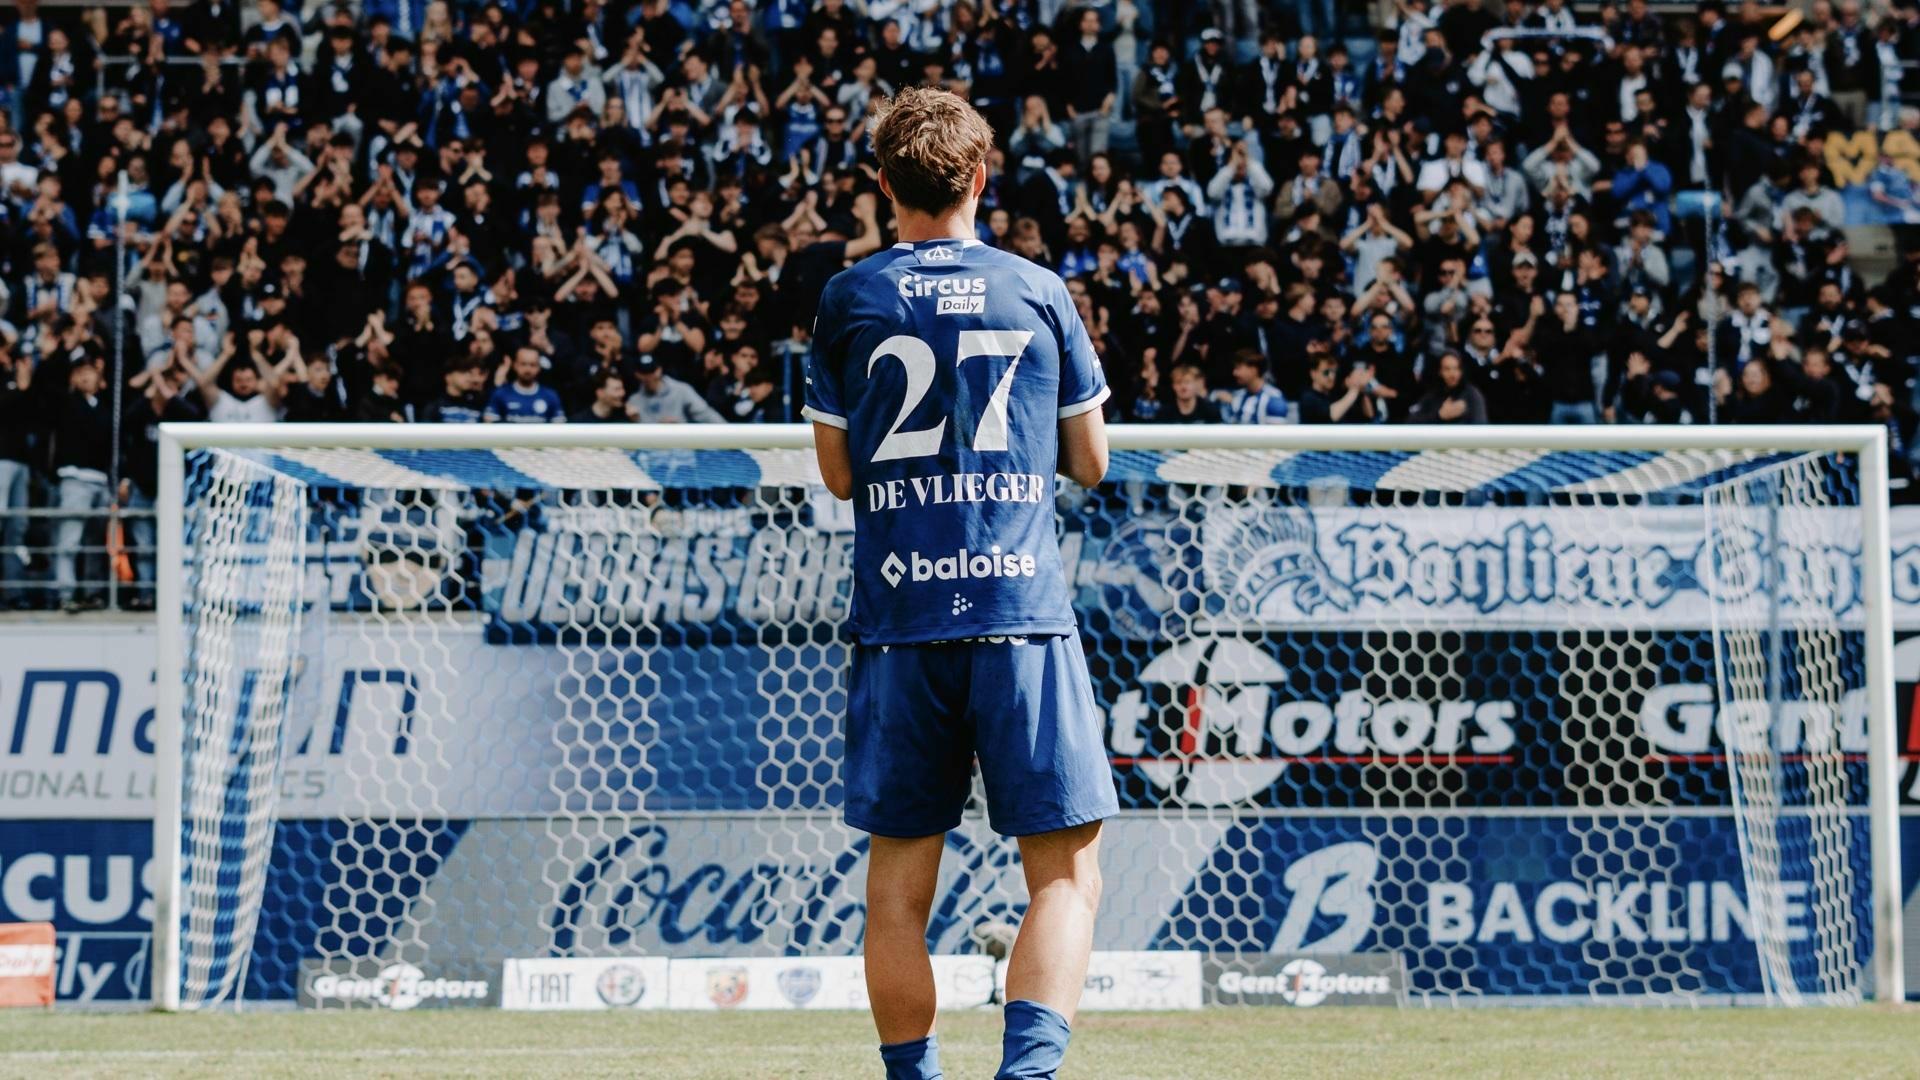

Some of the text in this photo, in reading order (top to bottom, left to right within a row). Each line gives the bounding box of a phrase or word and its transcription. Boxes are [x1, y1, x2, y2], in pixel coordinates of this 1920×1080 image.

[898, 275, 986, 297] Circus
[942, 298, 979, 312] Daily
[867, 330, 1035, 463] 27
[867, 473, 1044, 512] DE VLIEGER
[911, 546, 1036, 582] baloise
[1203, 685, 1517, 755] Motors
[1427, 880, 1811, 943] BACKLINE
[313, 975, 489, 1000] Gent Motors
[527, 973, 574, 1004] FIAT
[1218, 972, 1391, 995] Gent Motors
